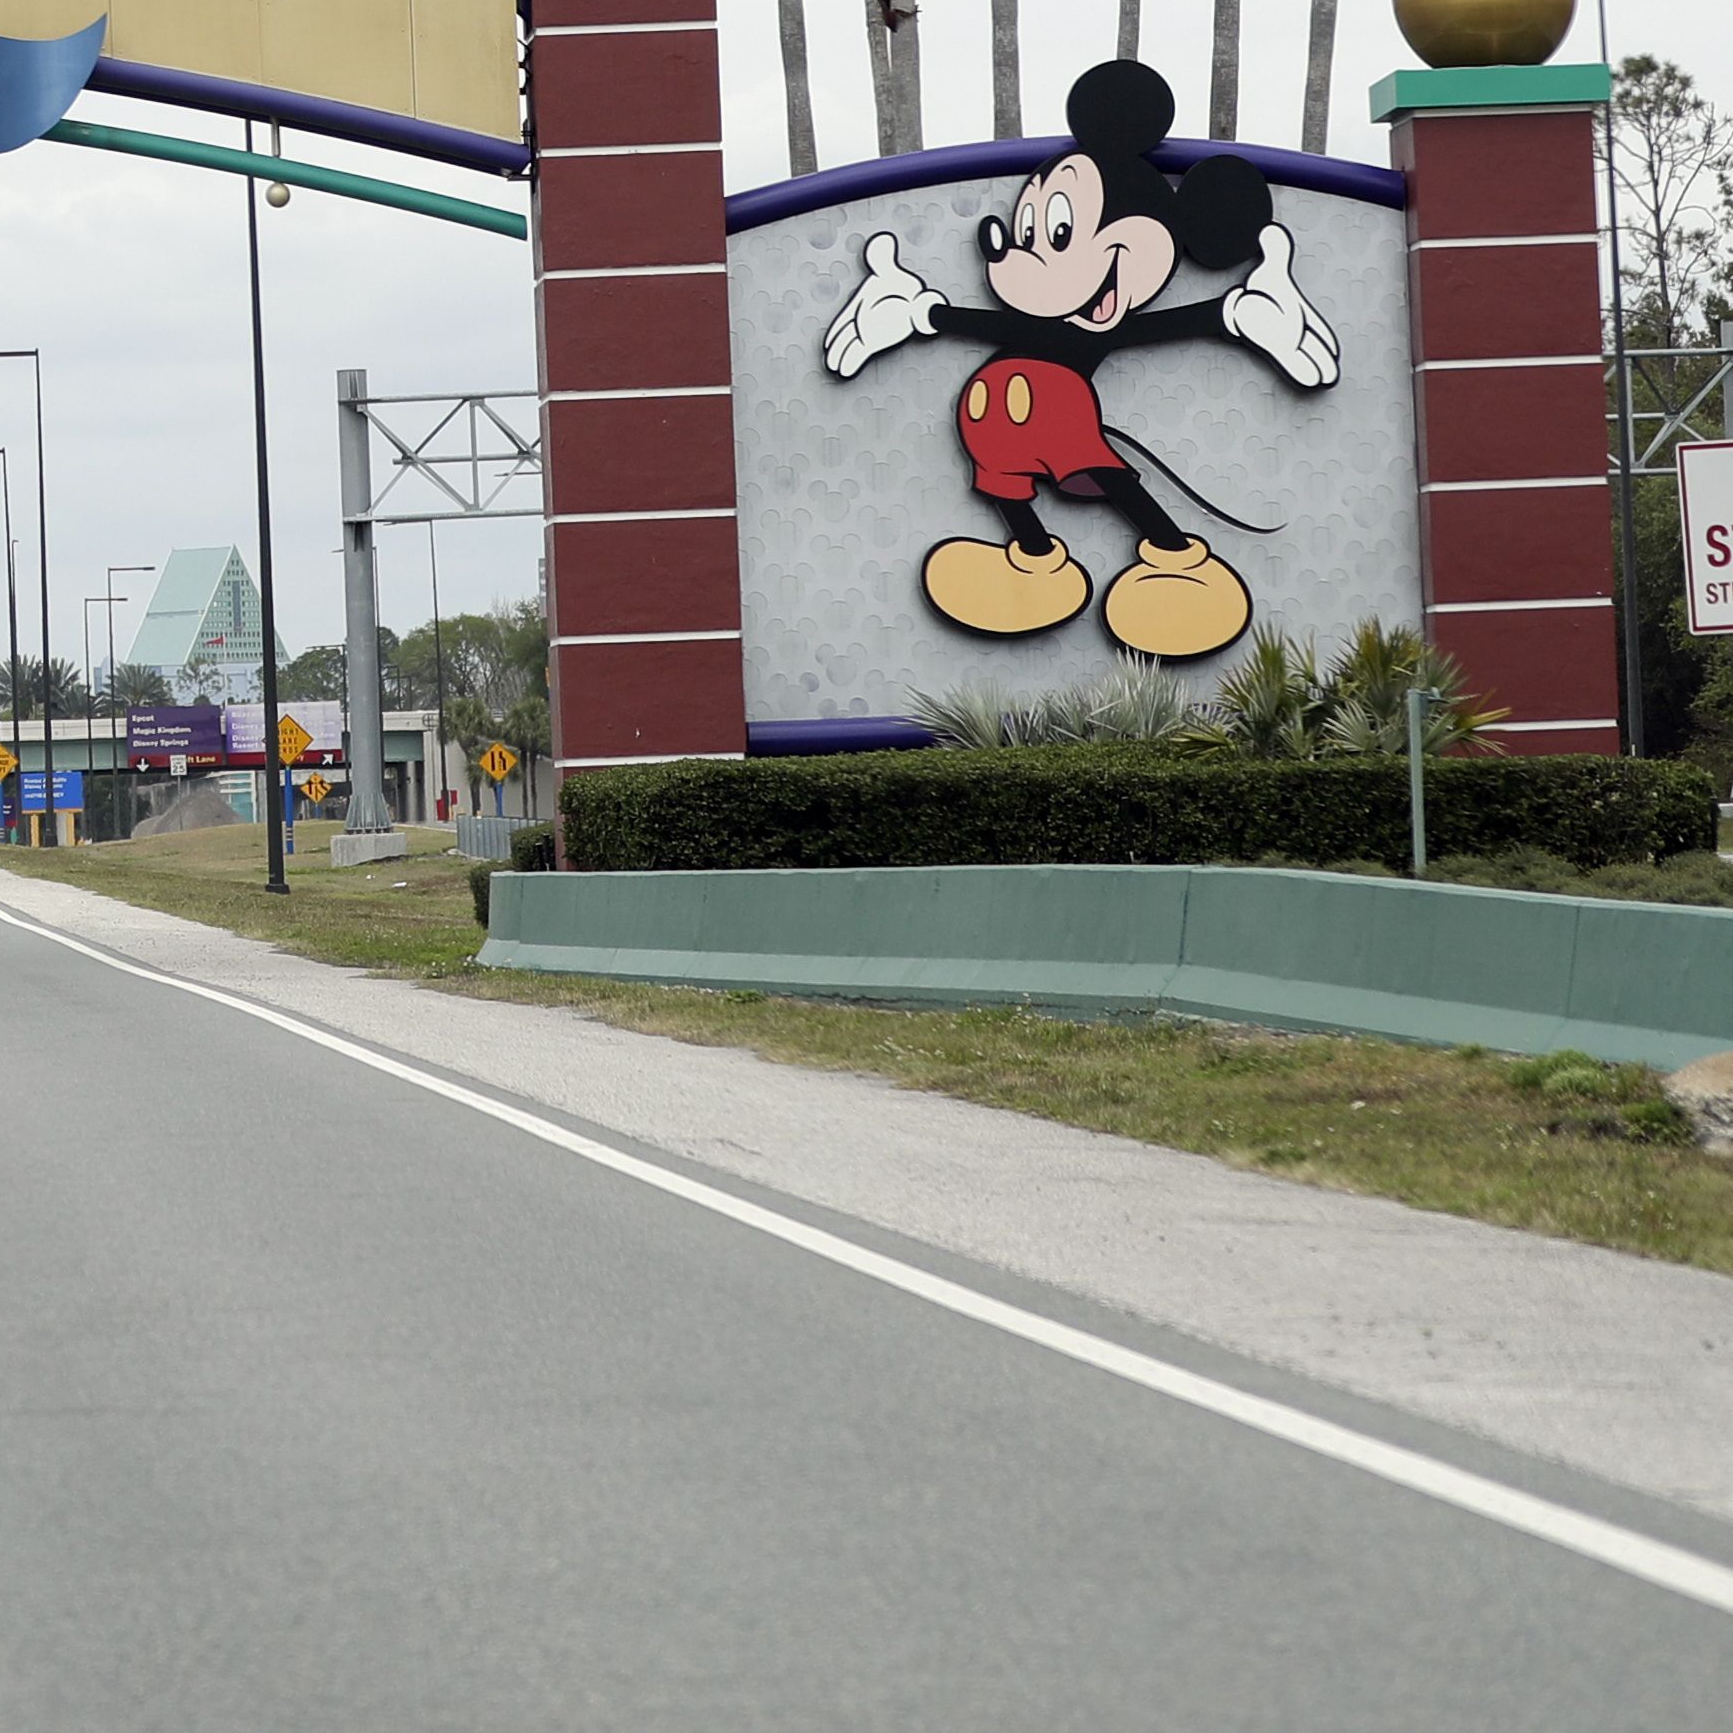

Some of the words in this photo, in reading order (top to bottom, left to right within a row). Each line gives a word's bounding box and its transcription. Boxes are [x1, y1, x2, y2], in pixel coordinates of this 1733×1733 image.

[1706, 524, 1733, 568] S
[1706, 582, 1733, 604] ST
[131, 714, 154, 722] Epcot
[132, 728, 156, 736] Magic
[157, 727, 192, 735] Kingdom
[132, 740, 159, 748] Disney
[159, 739, 189, 747] Springs
[196, 756, 216, 764] Lane
